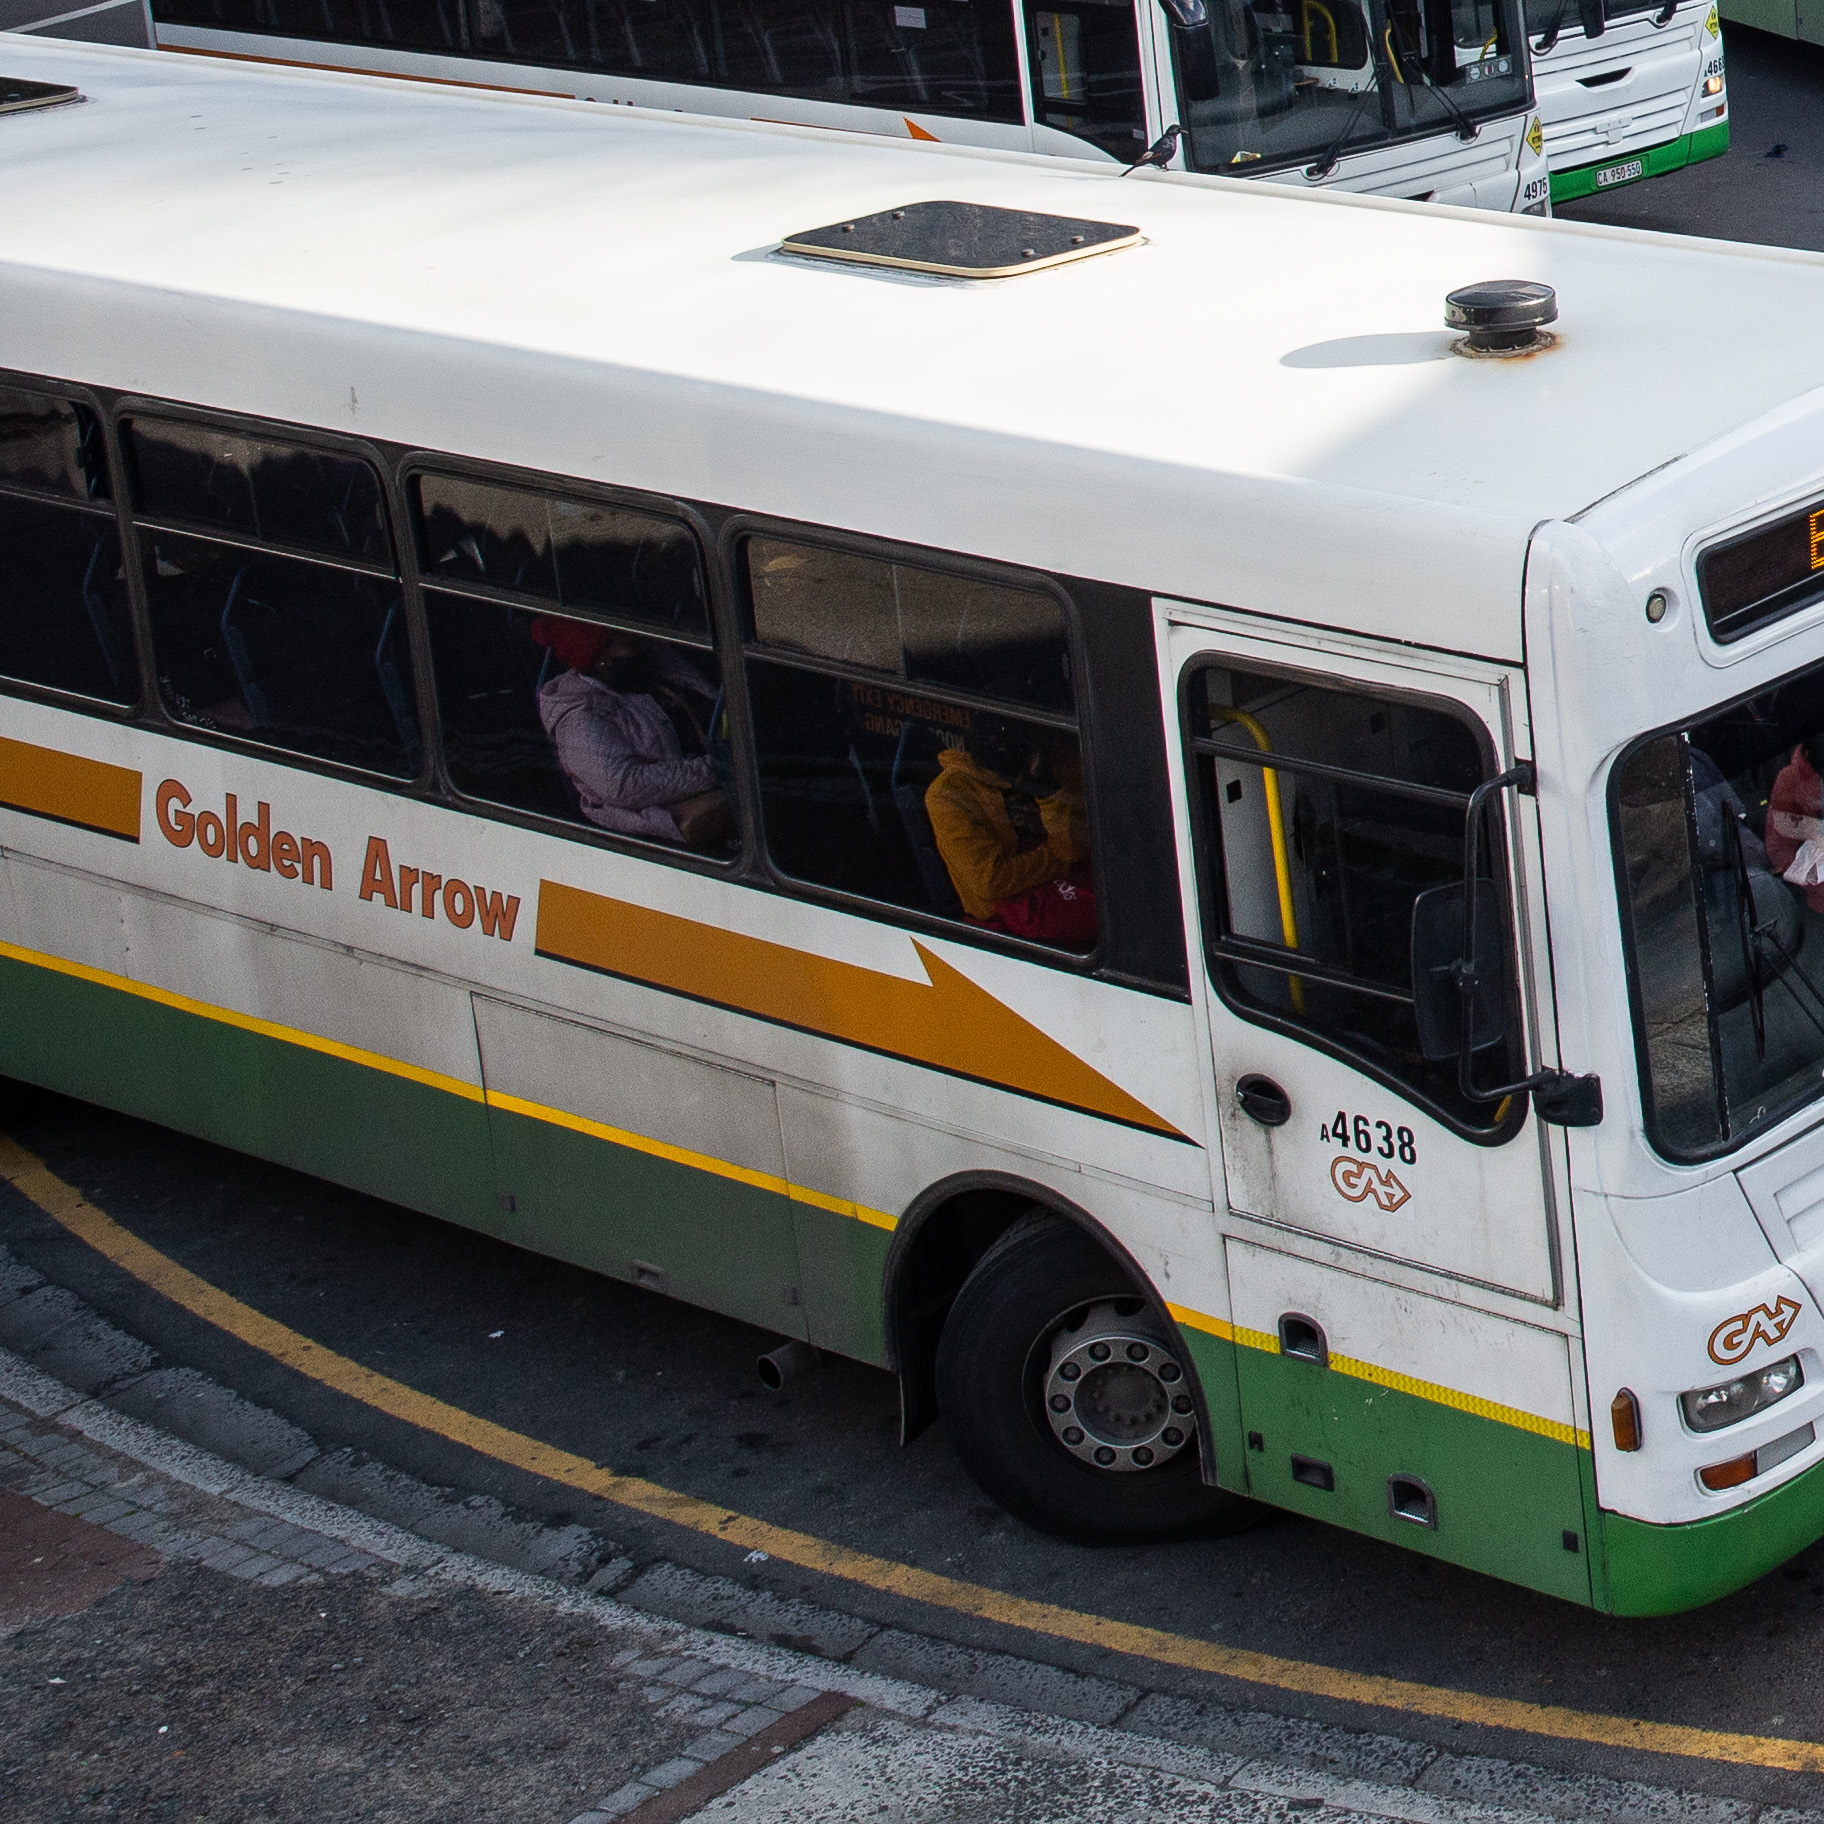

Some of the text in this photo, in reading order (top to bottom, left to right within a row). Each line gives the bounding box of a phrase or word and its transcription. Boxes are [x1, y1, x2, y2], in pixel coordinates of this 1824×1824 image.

[1523, 177, 1548, 201] 4975
[1597, 171, 1610, 186] CA
[155, 778, 521, 943] Golden Arrow
